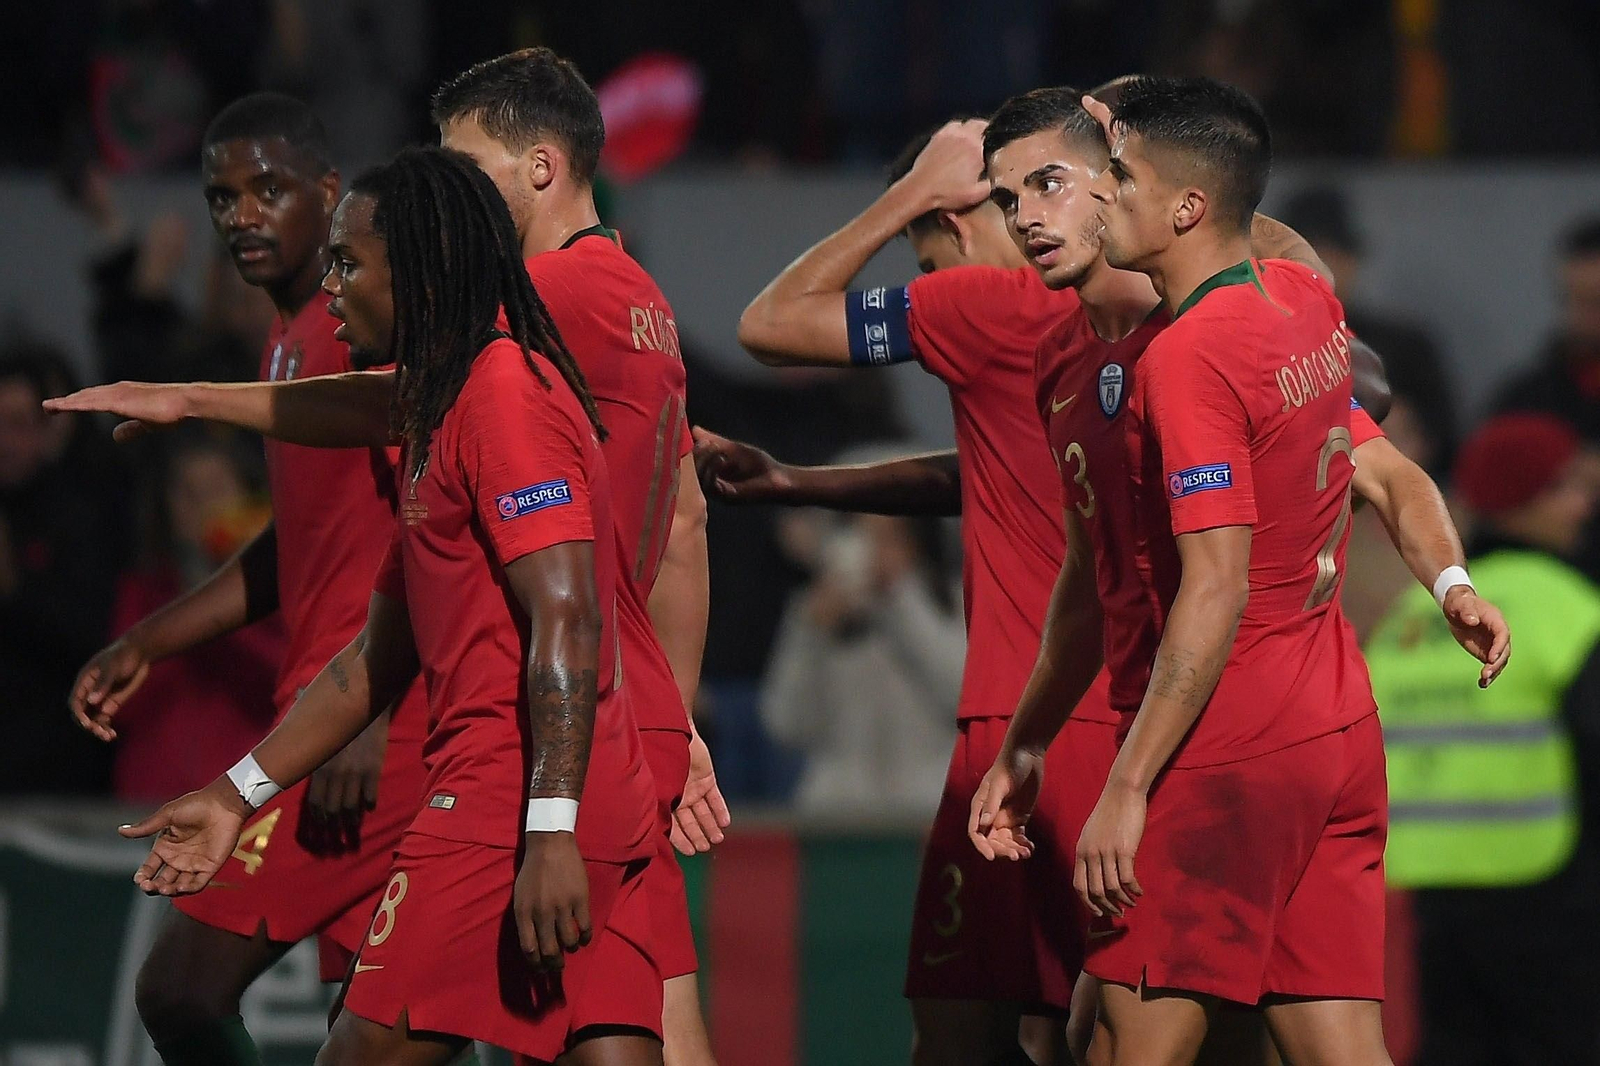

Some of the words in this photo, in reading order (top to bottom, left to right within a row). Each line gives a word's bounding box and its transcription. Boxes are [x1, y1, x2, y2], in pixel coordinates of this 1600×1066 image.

[1275, 354, 1320, 412] JOÃO
[517, 485, 569, 509] RESPECT
[1052, 442, 1095, 519] 3
[1182, 469, 1230, 488] RESPECT
[231, 806, 283, 876] 4
[369, 872, 408, 947] 8
[931, 862, 963, 938] 3
